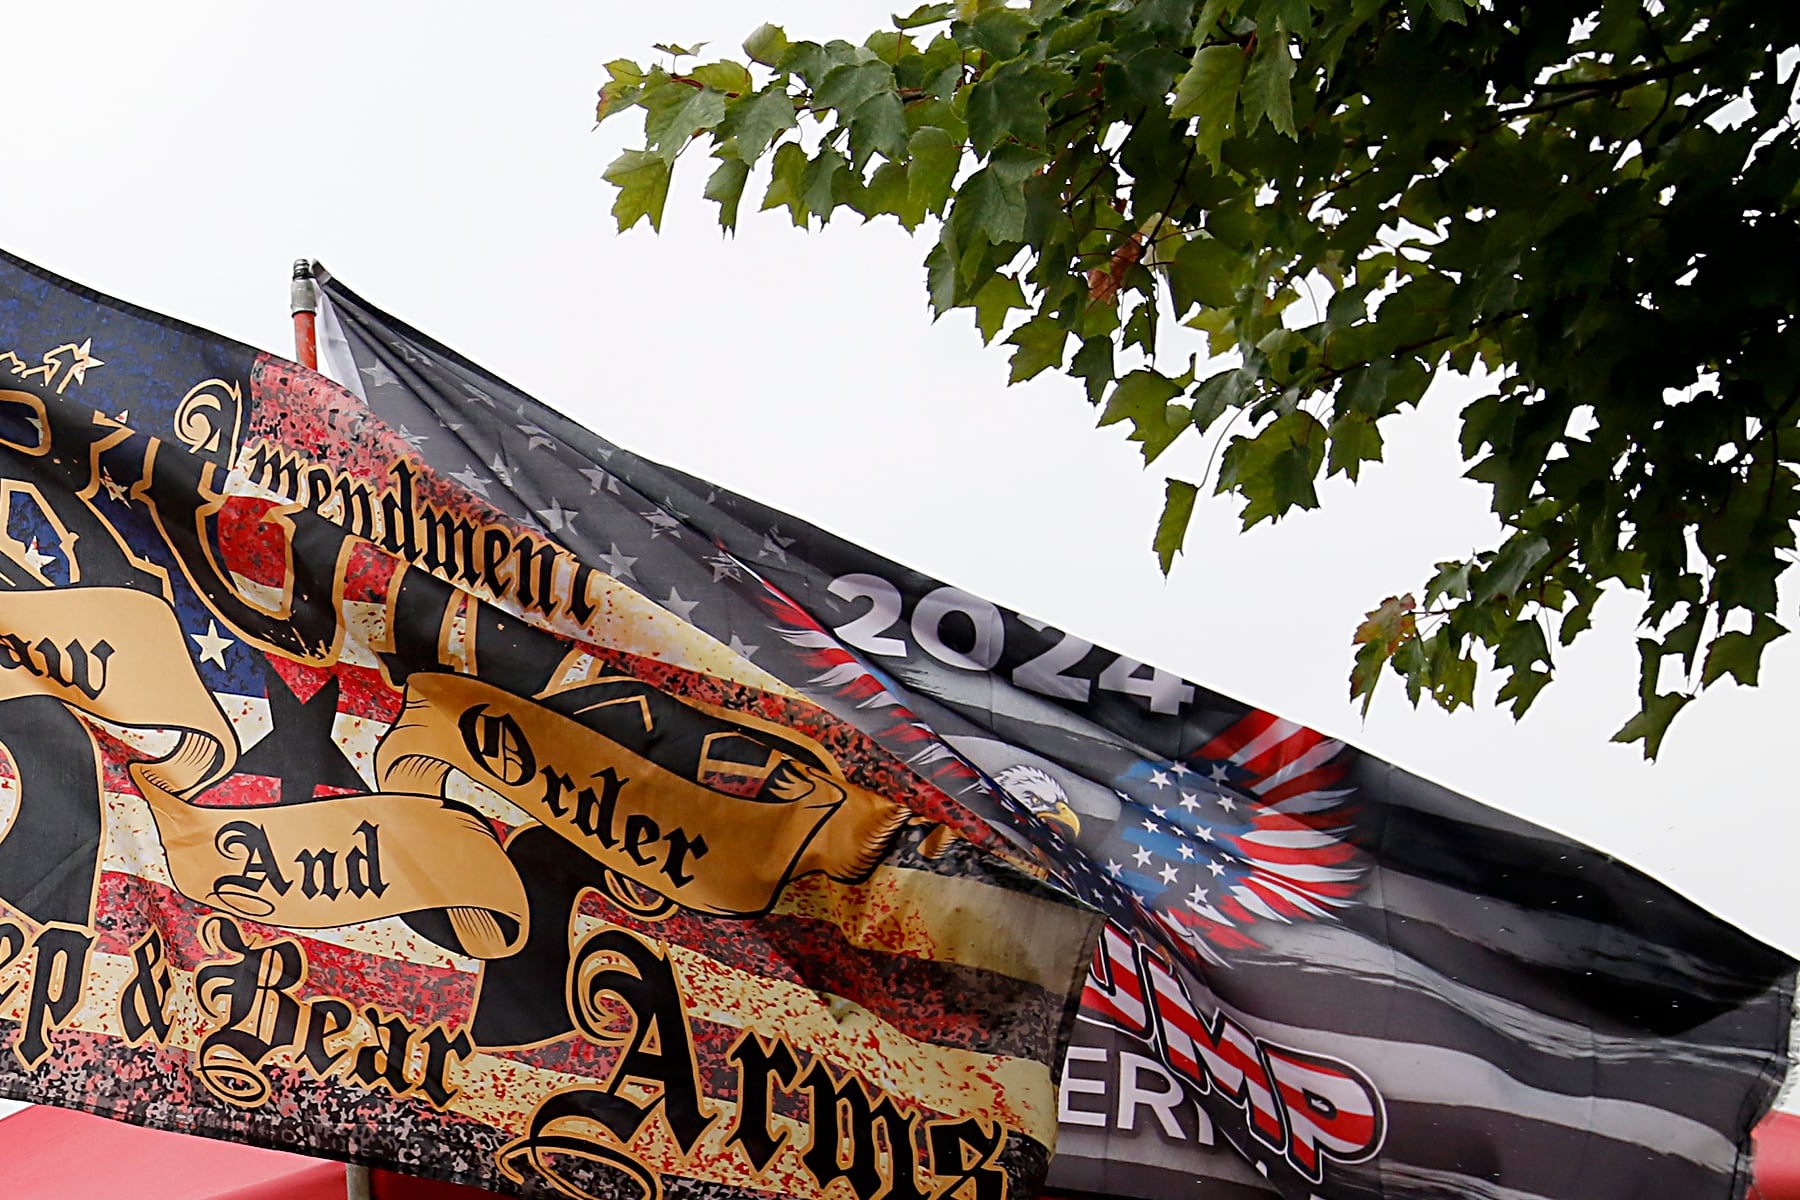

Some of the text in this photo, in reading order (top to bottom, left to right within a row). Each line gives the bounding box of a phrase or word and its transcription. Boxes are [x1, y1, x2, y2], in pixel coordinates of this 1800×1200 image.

[828, 573, 1195, 717] 2024
[206, 816, 392, 918] And
[457, 702, 709, 889] Order
[119, 934, 178, 1048] &
[198, 918, 474, 1106] Bear
